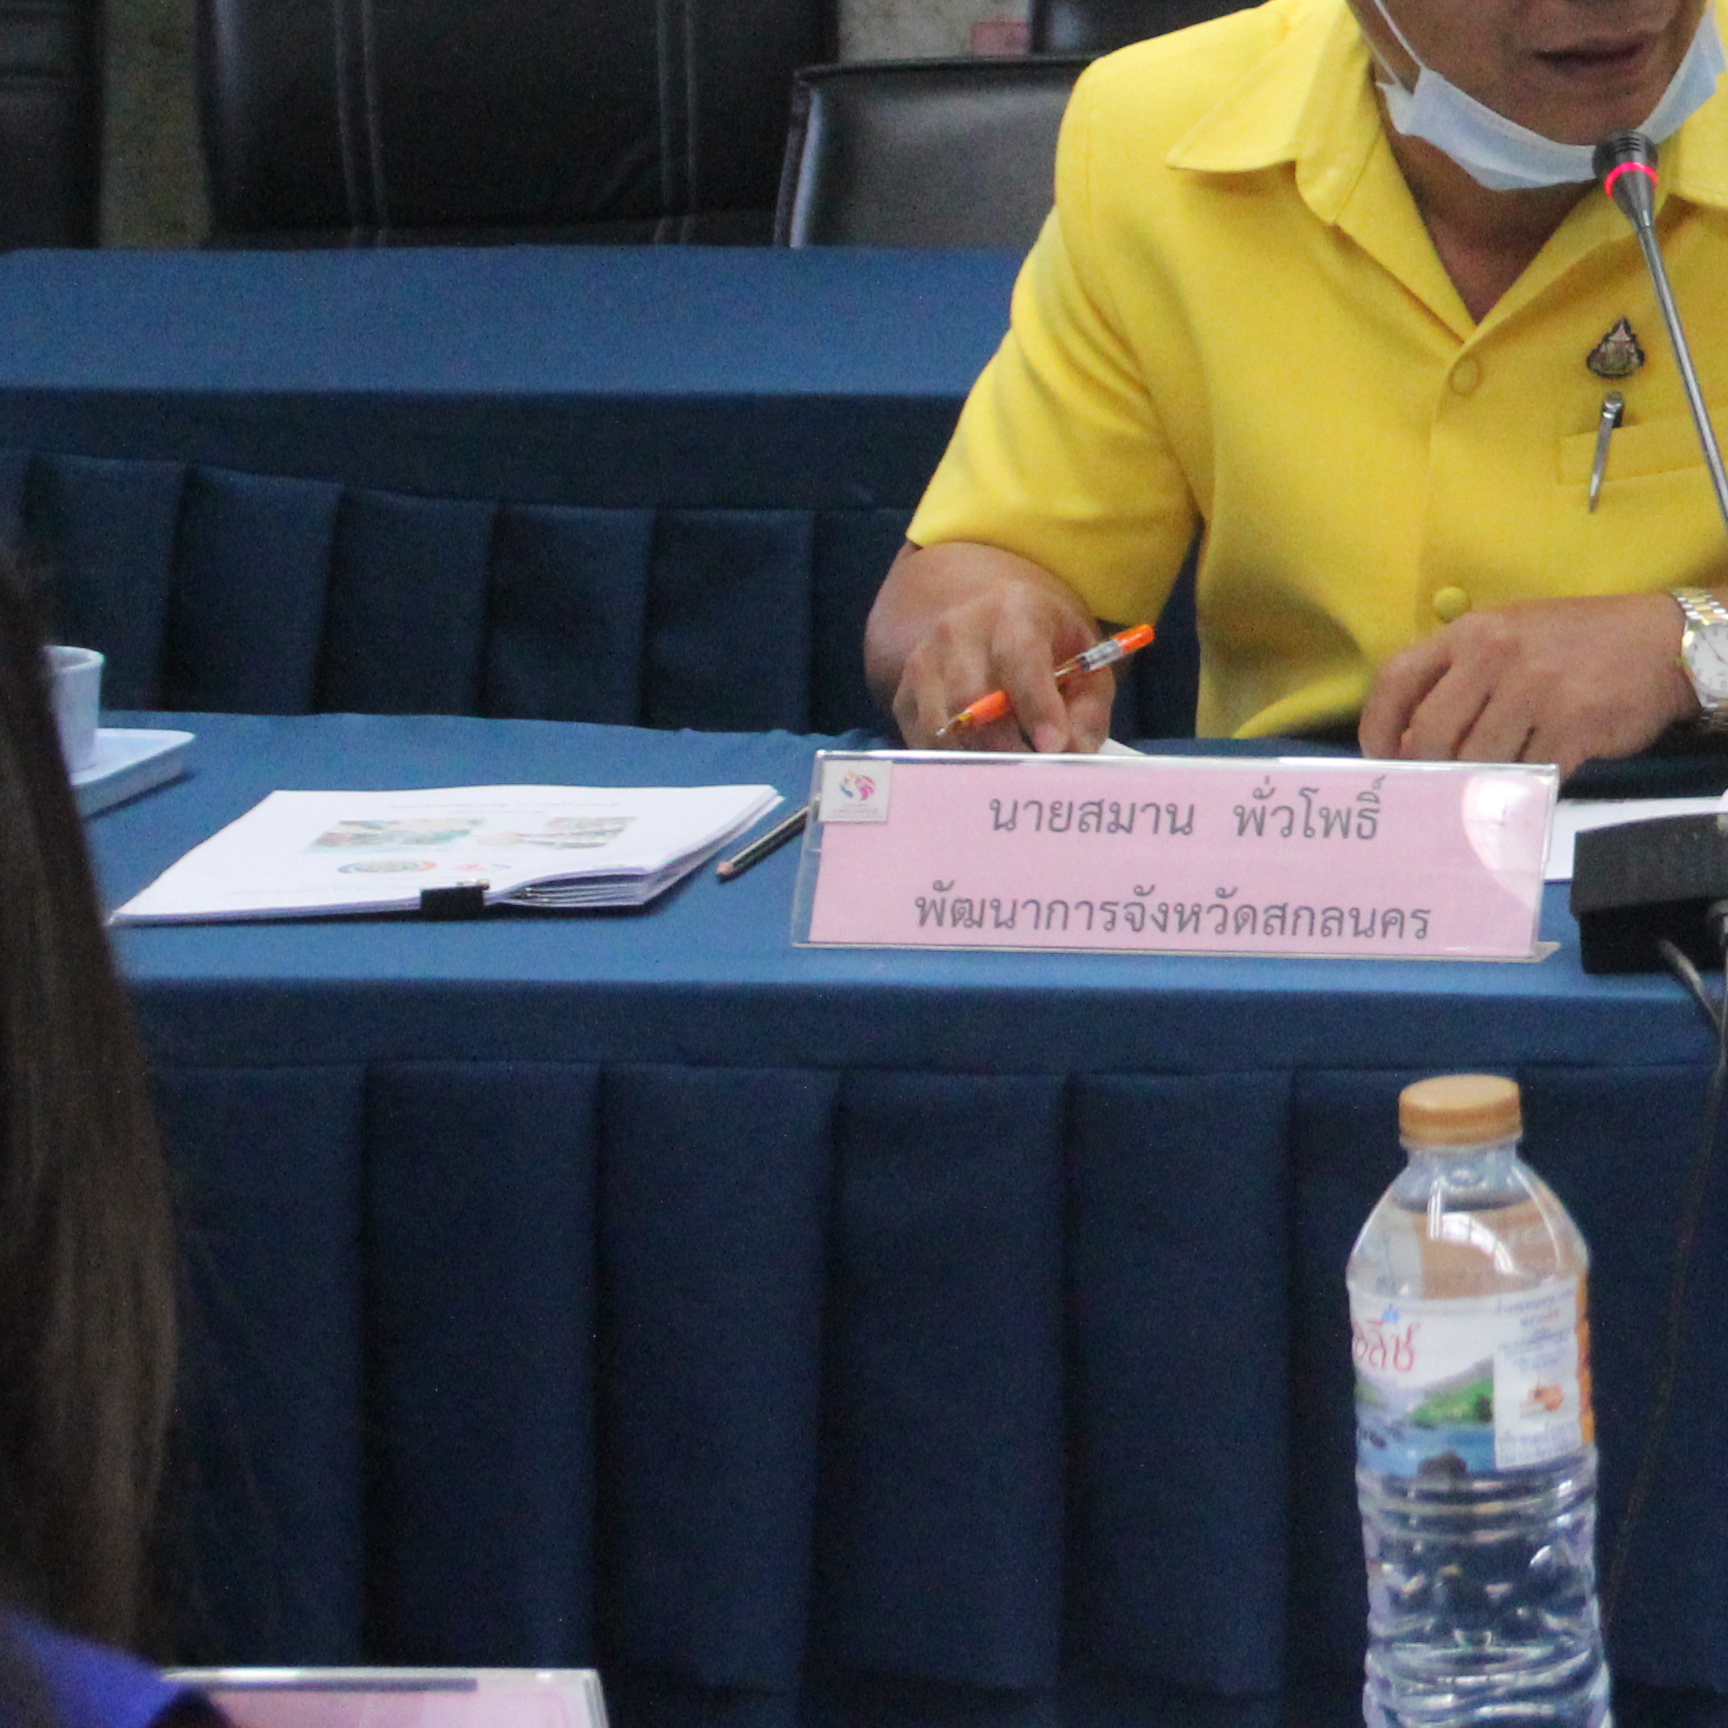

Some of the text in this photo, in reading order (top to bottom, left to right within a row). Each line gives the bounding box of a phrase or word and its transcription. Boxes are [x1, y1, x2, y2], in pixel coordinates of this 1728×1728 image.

[989, 775, 1386, 840] นายสมาน พั่วโพธิ์
[914, 880, 1431, 940] พัฒนาการจังหวัดสกลนคร
